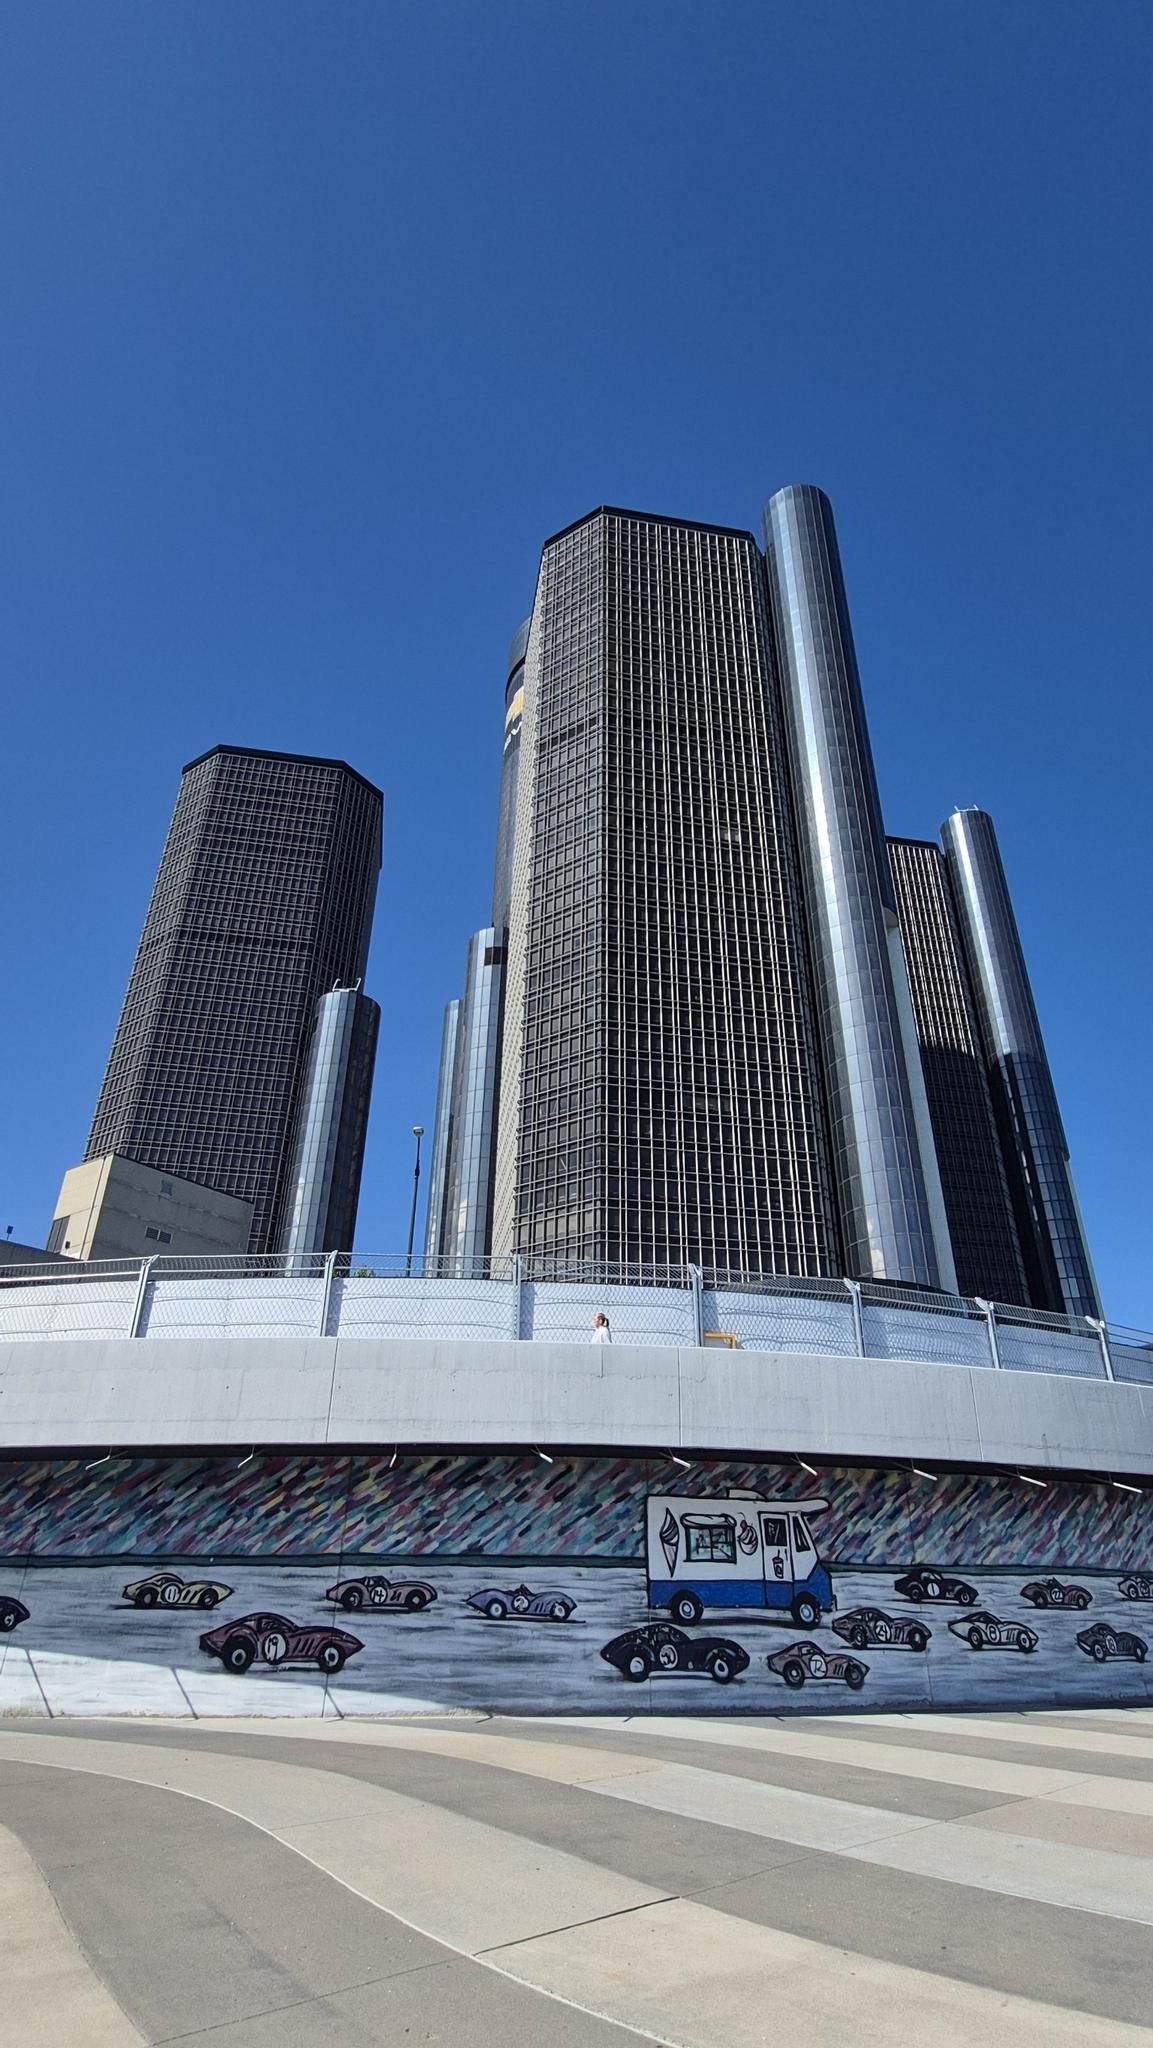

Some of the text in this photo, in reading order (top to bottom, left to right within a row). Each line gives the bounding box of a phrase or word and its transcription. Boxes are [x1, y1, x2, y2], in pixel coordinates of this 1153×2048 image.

[371, 1588, 385, 1604] 14
[876, 1624, 888, 1641] 24
[267, 1636, 279, 1659] 19
